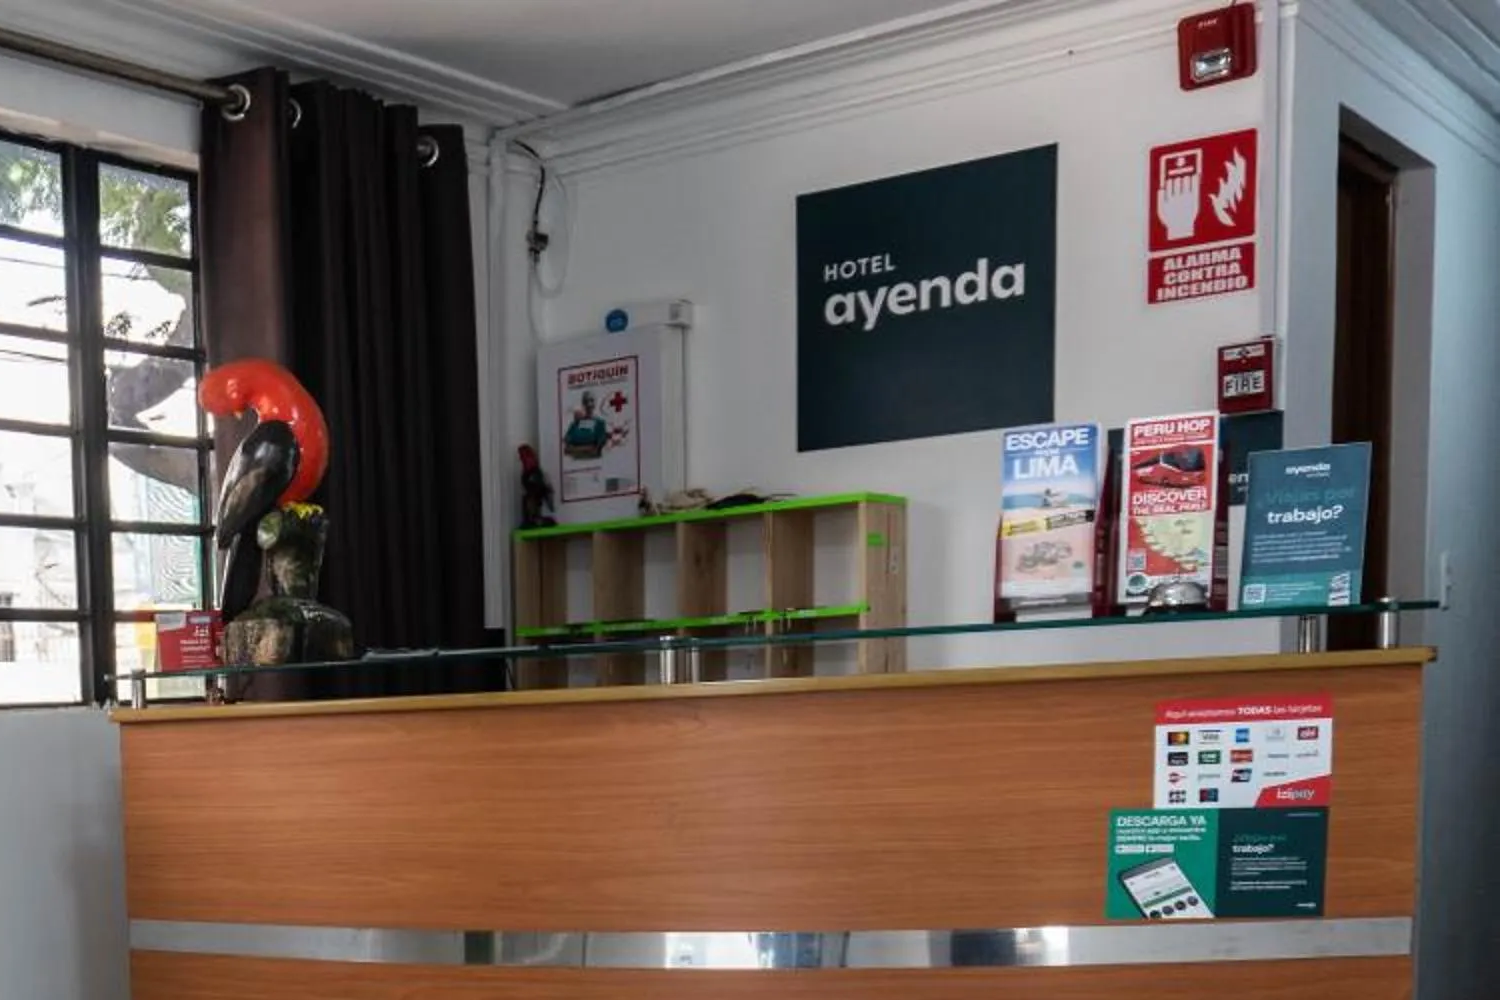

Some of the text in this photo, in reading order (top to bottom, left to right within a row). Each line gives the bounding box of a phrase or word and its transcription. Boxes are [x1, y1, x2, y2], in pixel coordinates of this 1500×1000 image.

[824, 253, 896, 283] HOTEL
[1164, 247, 1242, 271] ALARMA
[1164, 262, 1241, 285] CONTRA
[824, 257, 1026, 331] ayenda
[1157, 275, 1248, 301] INCENDIO
[1225, 376, 1262, 393] FIRE
[1006, 427, 1089, 451] ESCAPE
[1134, 419, 1211, 438] PERU HOP
[1014, 454, 1079, 479] LIMA
[1133, 487, 1207, 504] DISCOVER
[1267, 504, 1344, 525] trabajo?
[1117, 815, 1187, 827] DESCARGA
